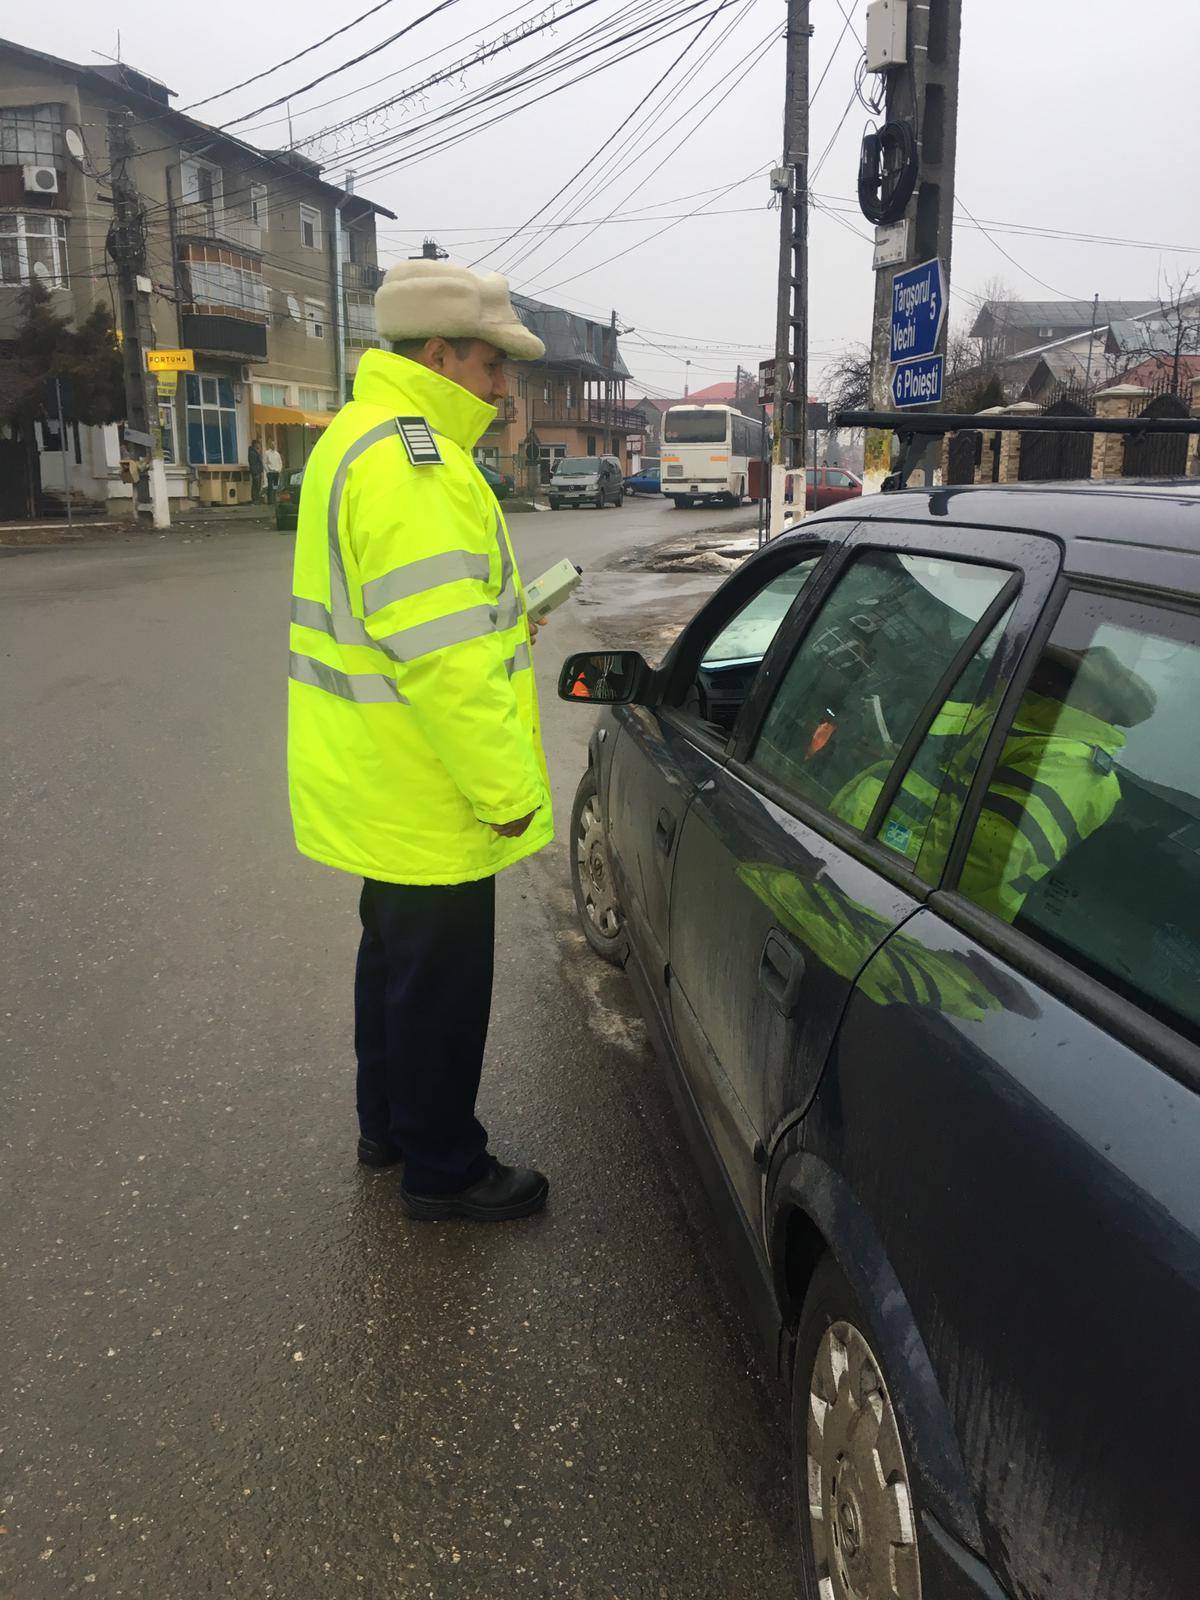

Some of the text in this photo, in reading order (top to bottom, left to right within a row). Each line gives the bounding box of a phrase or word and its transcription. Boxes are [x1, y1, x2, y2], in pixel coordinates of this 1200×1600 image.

[930, 292, 936, 319] 5
[893, 318, 916, 351] Vechi
[149, 355, 187, 363] FORTUNA
[896, 373, 902, 398] 6
